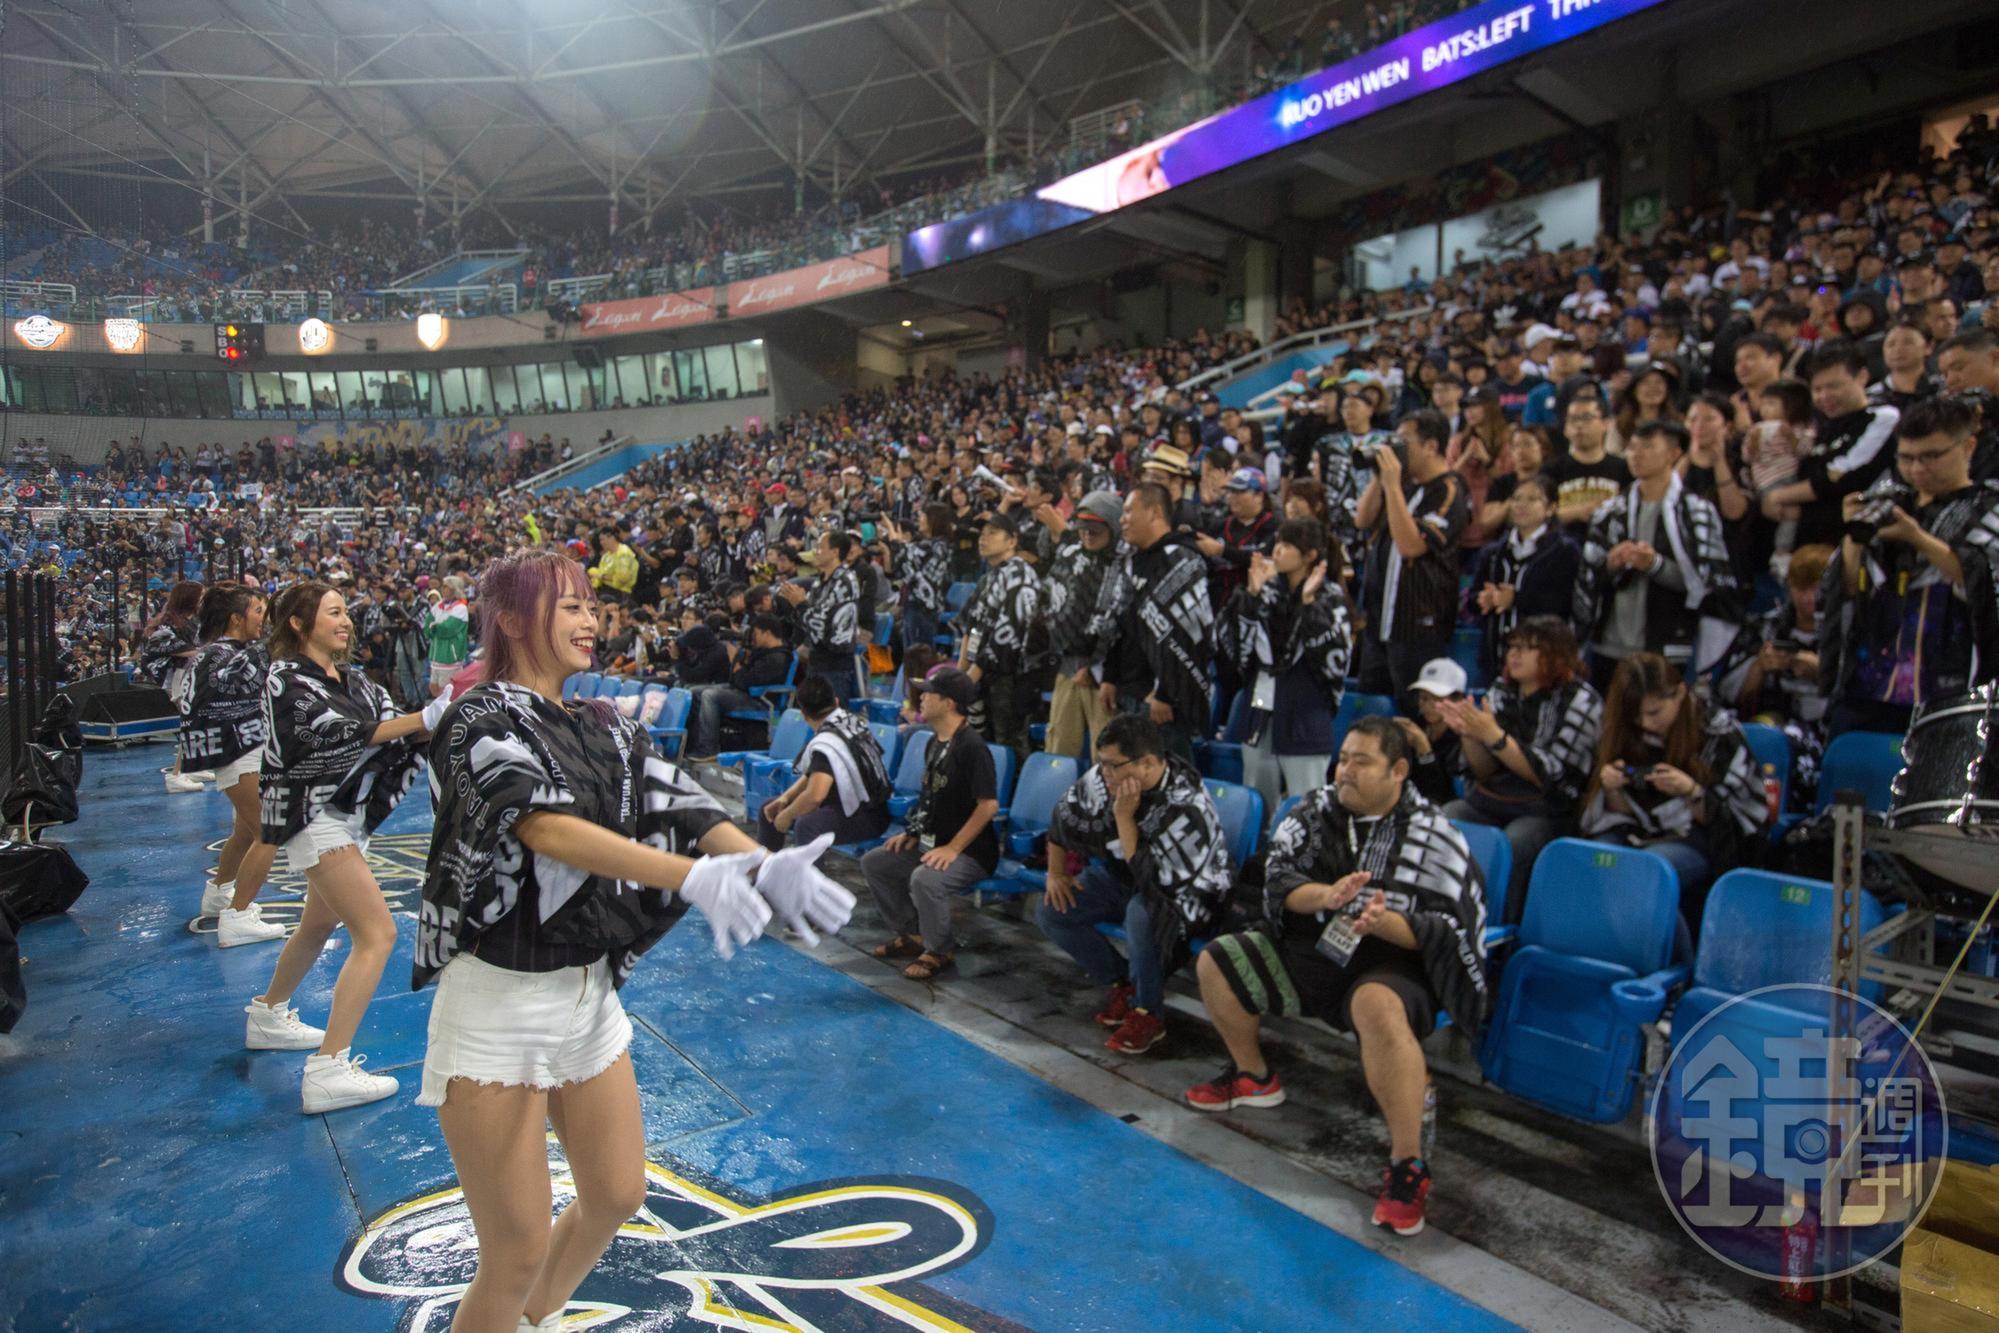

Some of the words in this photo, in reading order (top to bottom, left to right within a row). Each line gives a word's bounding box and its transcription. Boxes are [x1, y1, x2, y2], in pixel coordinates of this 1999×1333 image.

[1322, 78, 1361, 110] YEN
[1361, 57, 1410, 94] WEN
[217, 326, 226, 336] S
[218, 337, 227, 347] B
[259, 786, 291, 827] RE
[415, 899, 460, 969] RE
